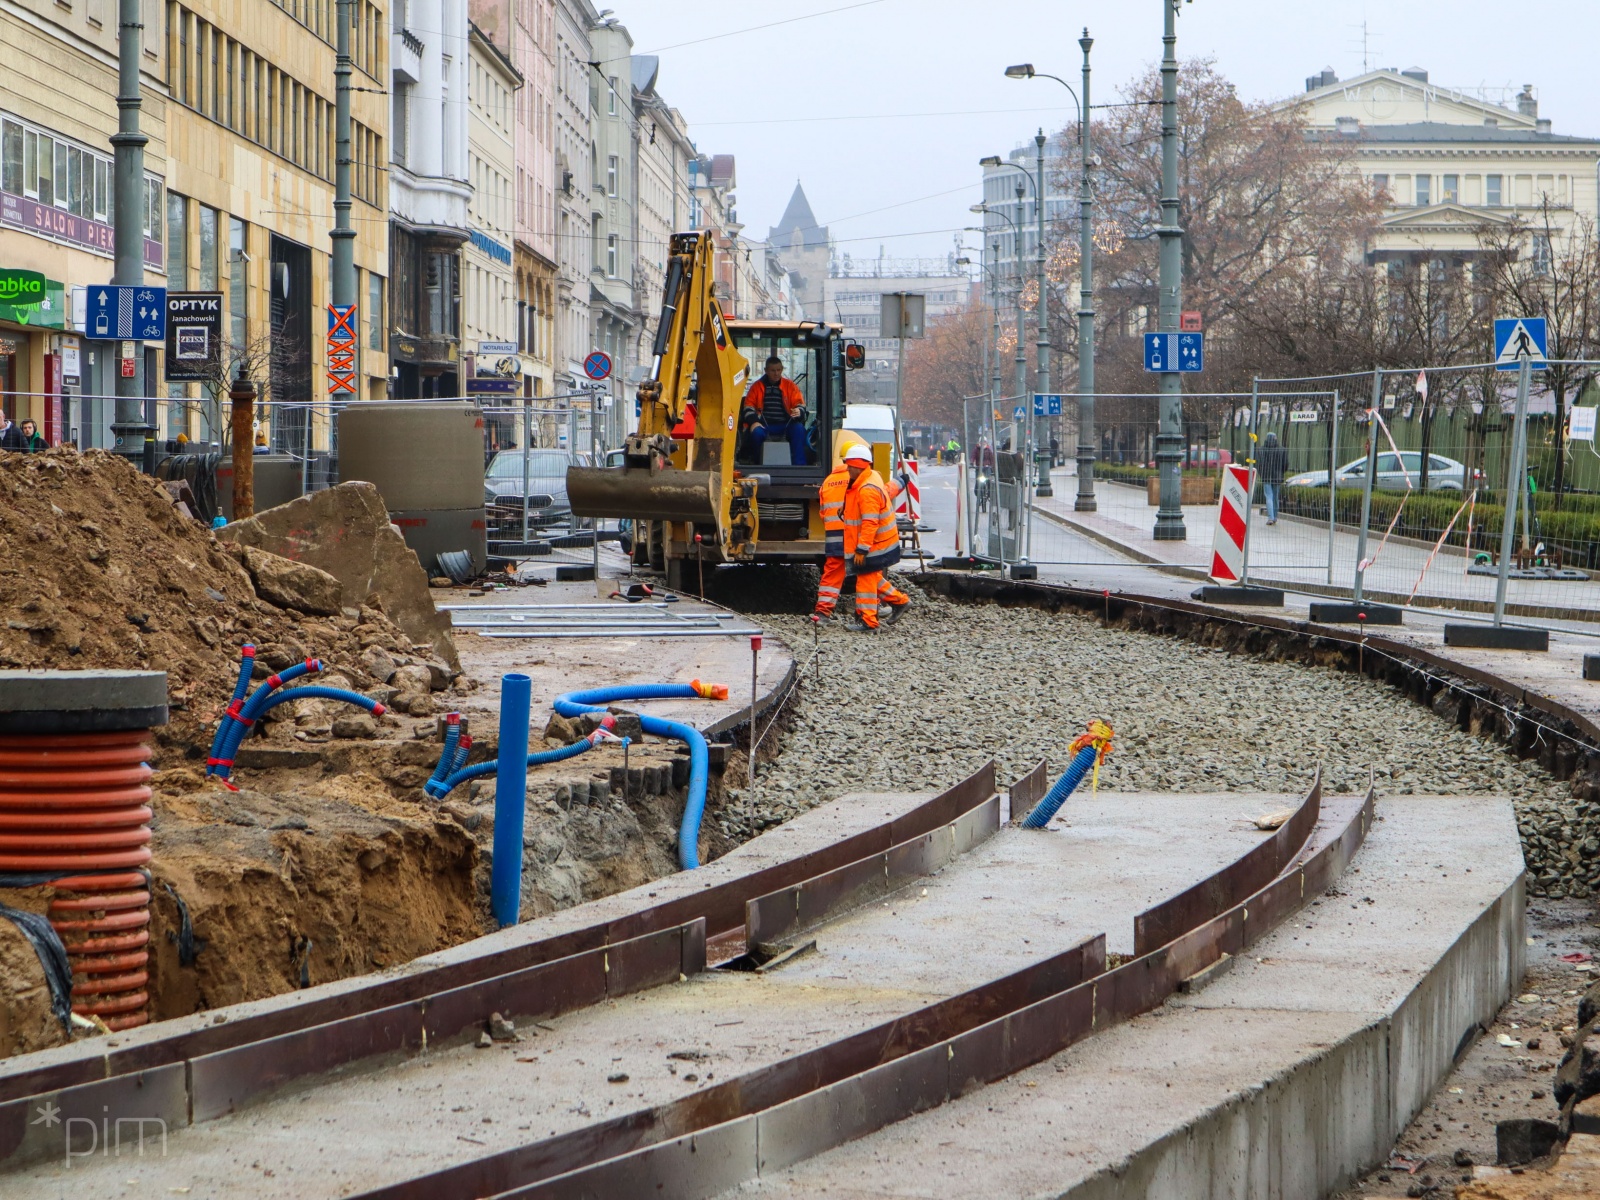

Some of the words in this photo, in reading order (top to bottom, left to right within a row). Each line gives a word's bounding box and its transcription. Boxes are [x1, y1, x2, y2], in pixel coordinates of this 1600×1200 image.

[35, 206, 75, 237] SALON
[0, 277, 41, 293] abka
[168, 299, 219, 311] OPTYK
[172, 314, 215, 322] Janachowski
